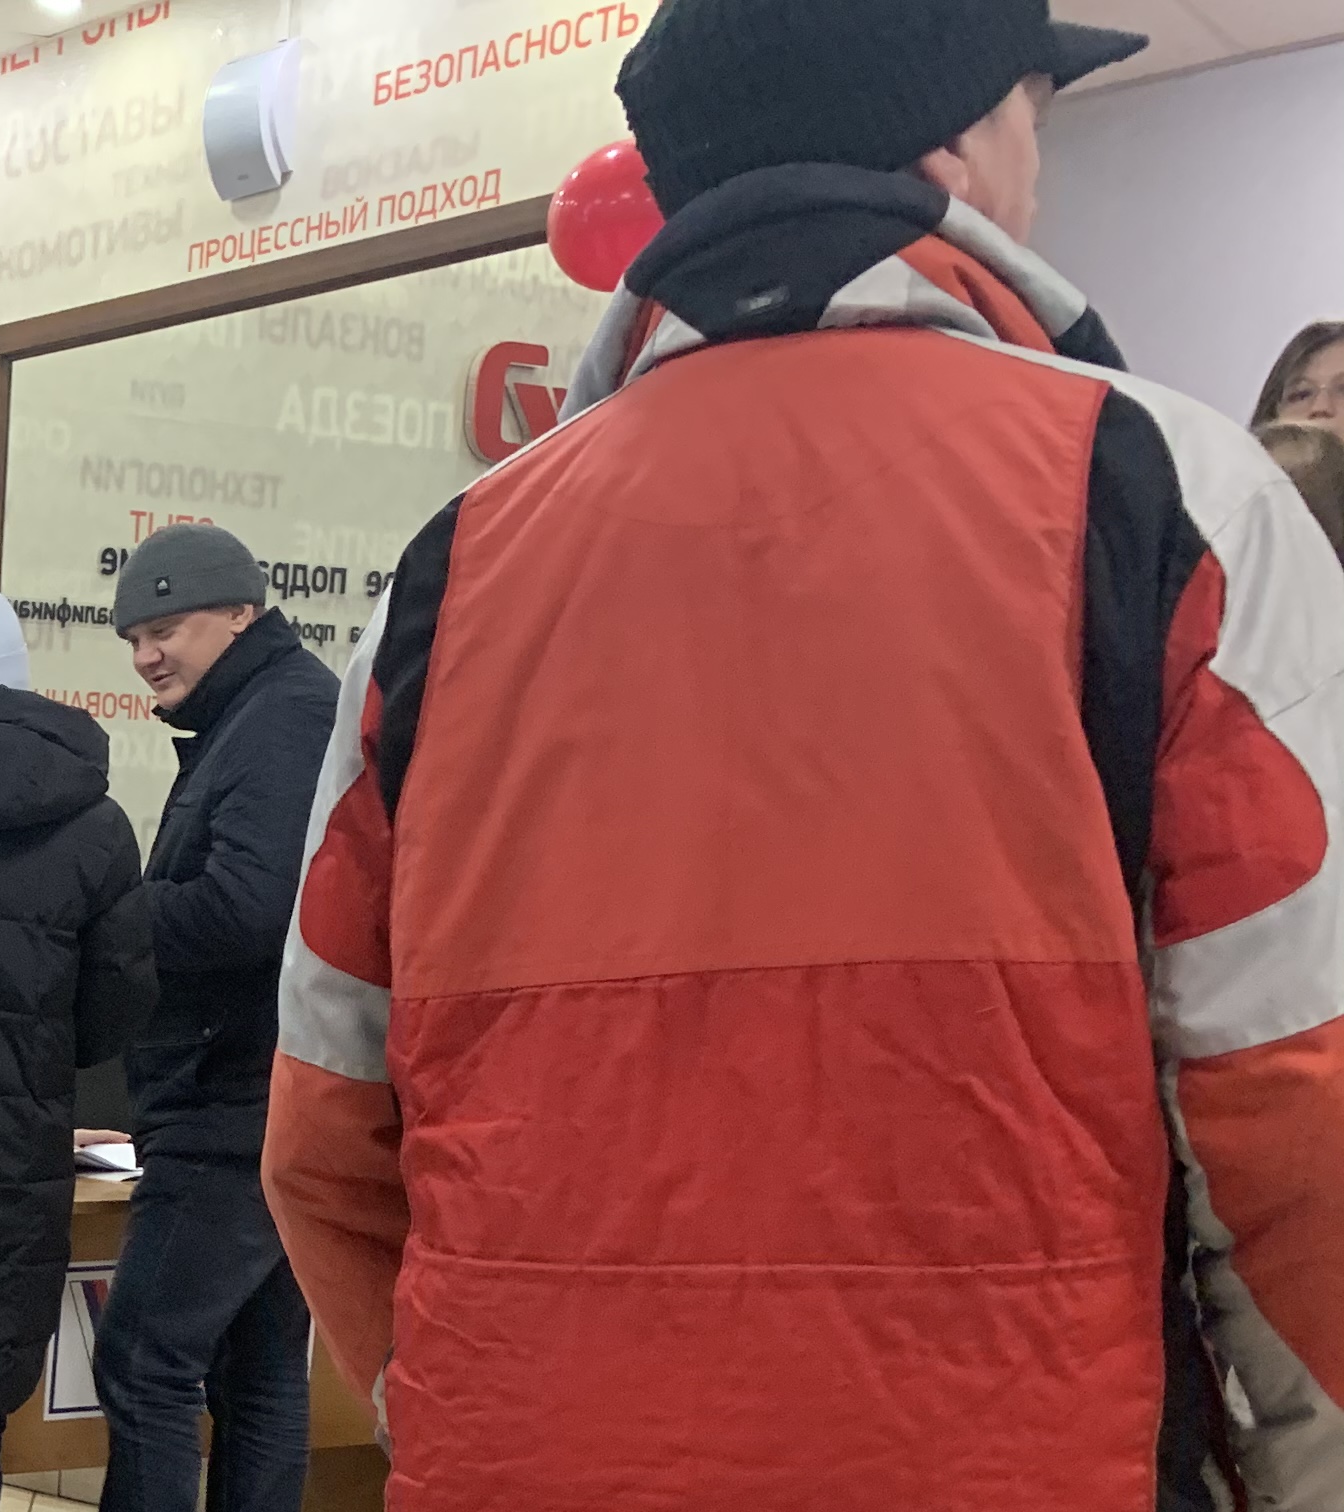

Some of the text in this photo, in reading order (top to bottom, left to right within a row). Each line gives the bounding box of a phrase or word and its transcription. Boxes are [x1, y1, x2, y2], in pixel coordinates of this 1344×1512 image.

[372, 4, 640, 106] БЕЗОПАСНОСТЬ
[187, 168, 503, 273] ПРОЦЕССНЫЙ ПОДХОД
